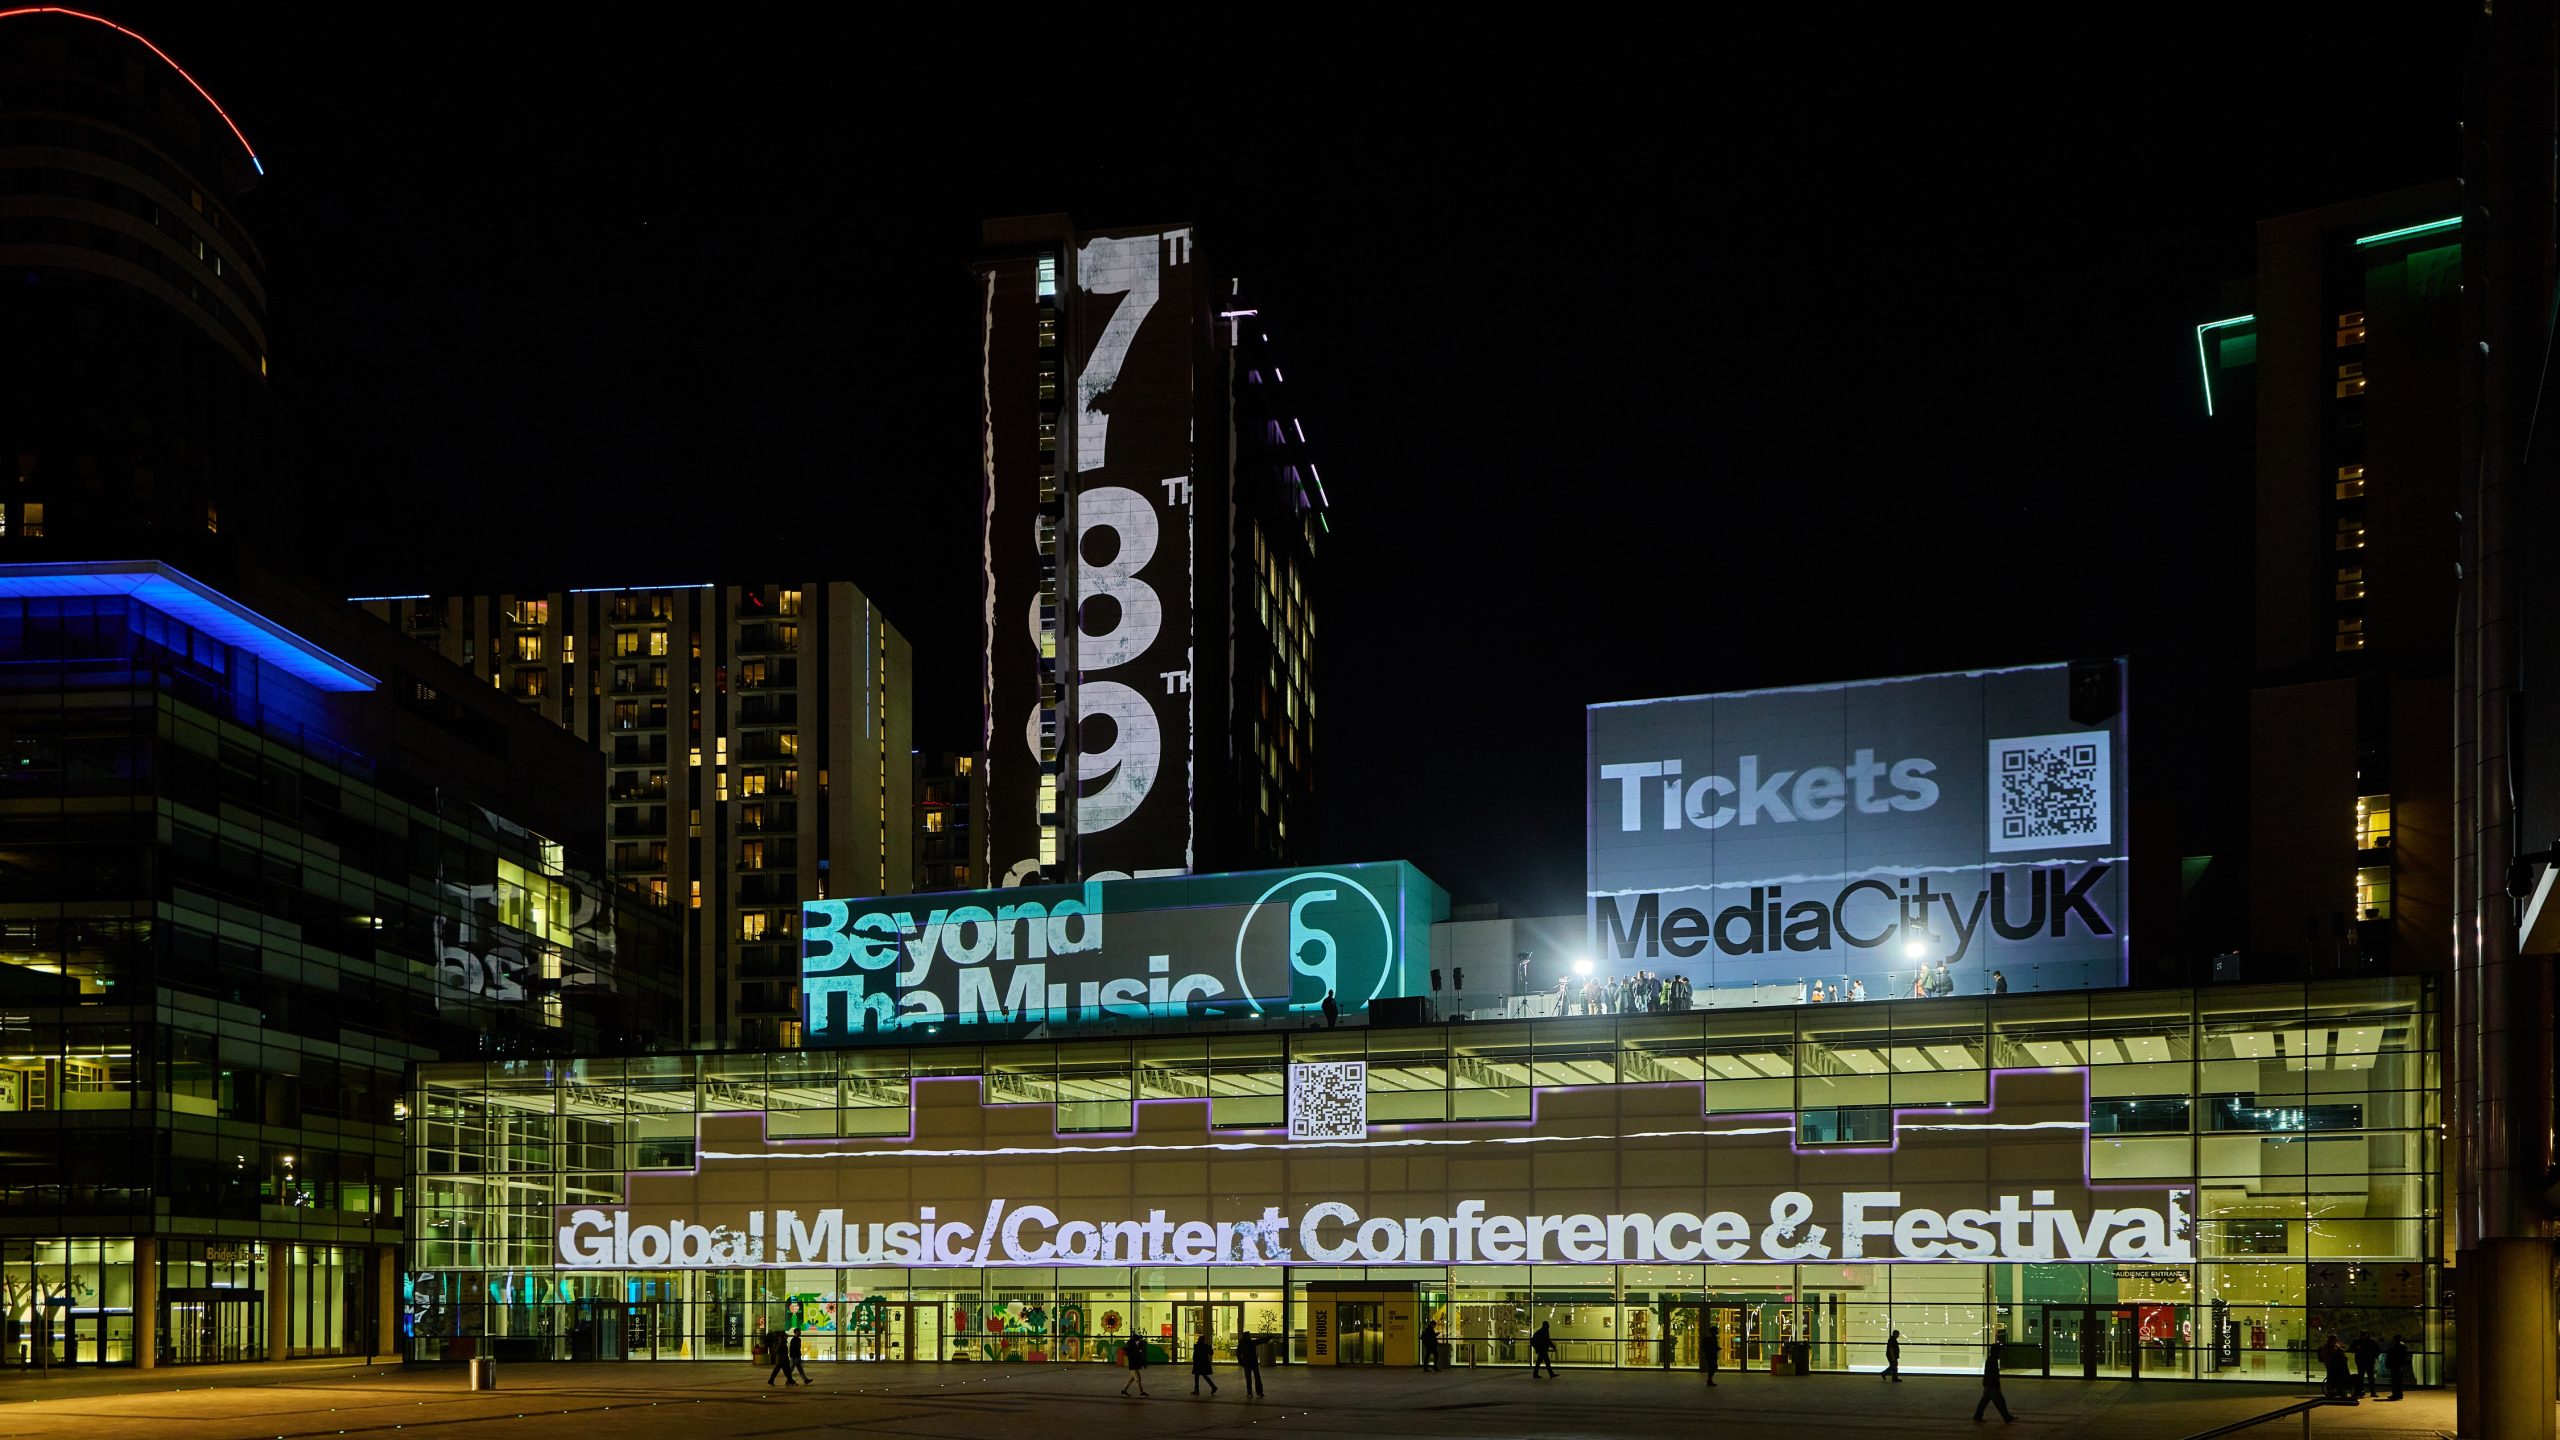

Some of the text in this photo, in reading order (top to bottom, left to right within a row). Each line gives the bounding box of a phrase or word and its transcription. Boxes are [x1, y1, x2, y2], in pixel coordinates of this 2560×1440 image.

[1601, 749, 1939, 832] Tickets
[803, 881, 1103, 987] Beyond
[1595, 866, 2115, 964] MediaCityUK
[959, 955, 1226, 1026] Music
[207, 1247, 236, 1264] Bridge
[558, 1189, 2191, 1267] Global Music/Content Conference & Festival
[1316, 1310, 1327, 1356] HOT HOUSE
